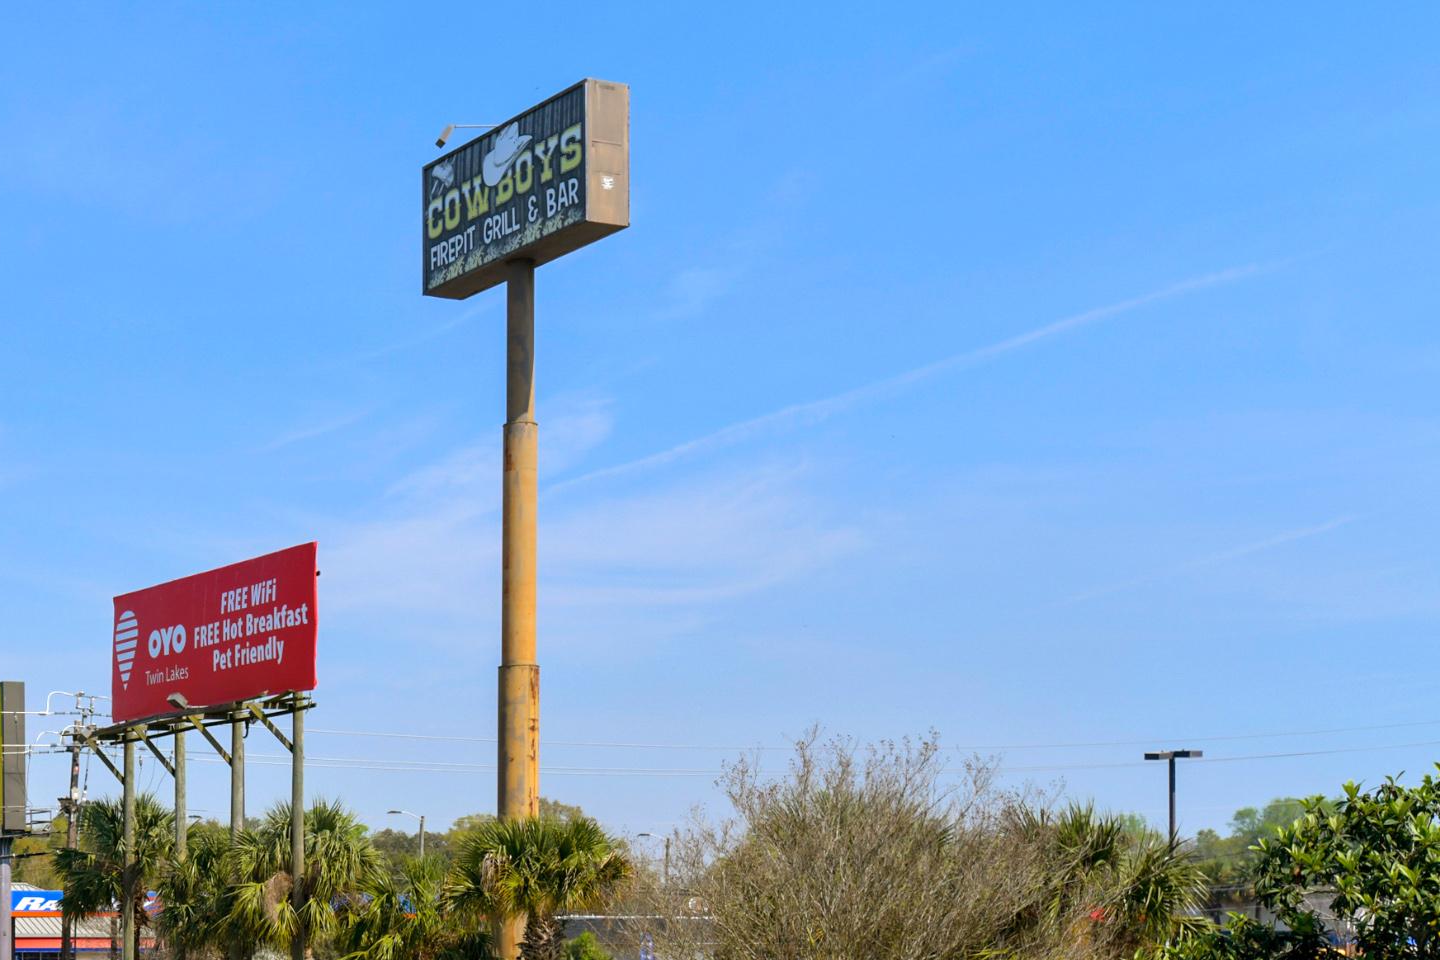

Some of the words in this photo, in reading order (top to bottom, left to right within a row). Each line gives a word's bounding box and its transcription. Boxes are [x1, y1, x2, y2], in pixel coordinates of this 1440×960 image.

[427, 122, 583, 239] COWBOYS
[430, 225, 475, 270] FIREPIT
[483, 208, 520, 244] GRILL
[528, 195, 538, 222] &
[546, 178, 579, 218] BAR
[221, 587, 248, 614] FREE
[251, 578, 277, 607] WiFi
[148, 623, 187, 659] OYO
[194, 621, 220, 648] FREE
[223, 619, 243, 641] Hot
[246, 603, 308, 637] Breakfast
[213, 649, 232, 671] Pet
[235, 636, 284, 667] Friendly
[145, 669, 164, 686] Twin
[166, 665, 189, 682] Lakes
